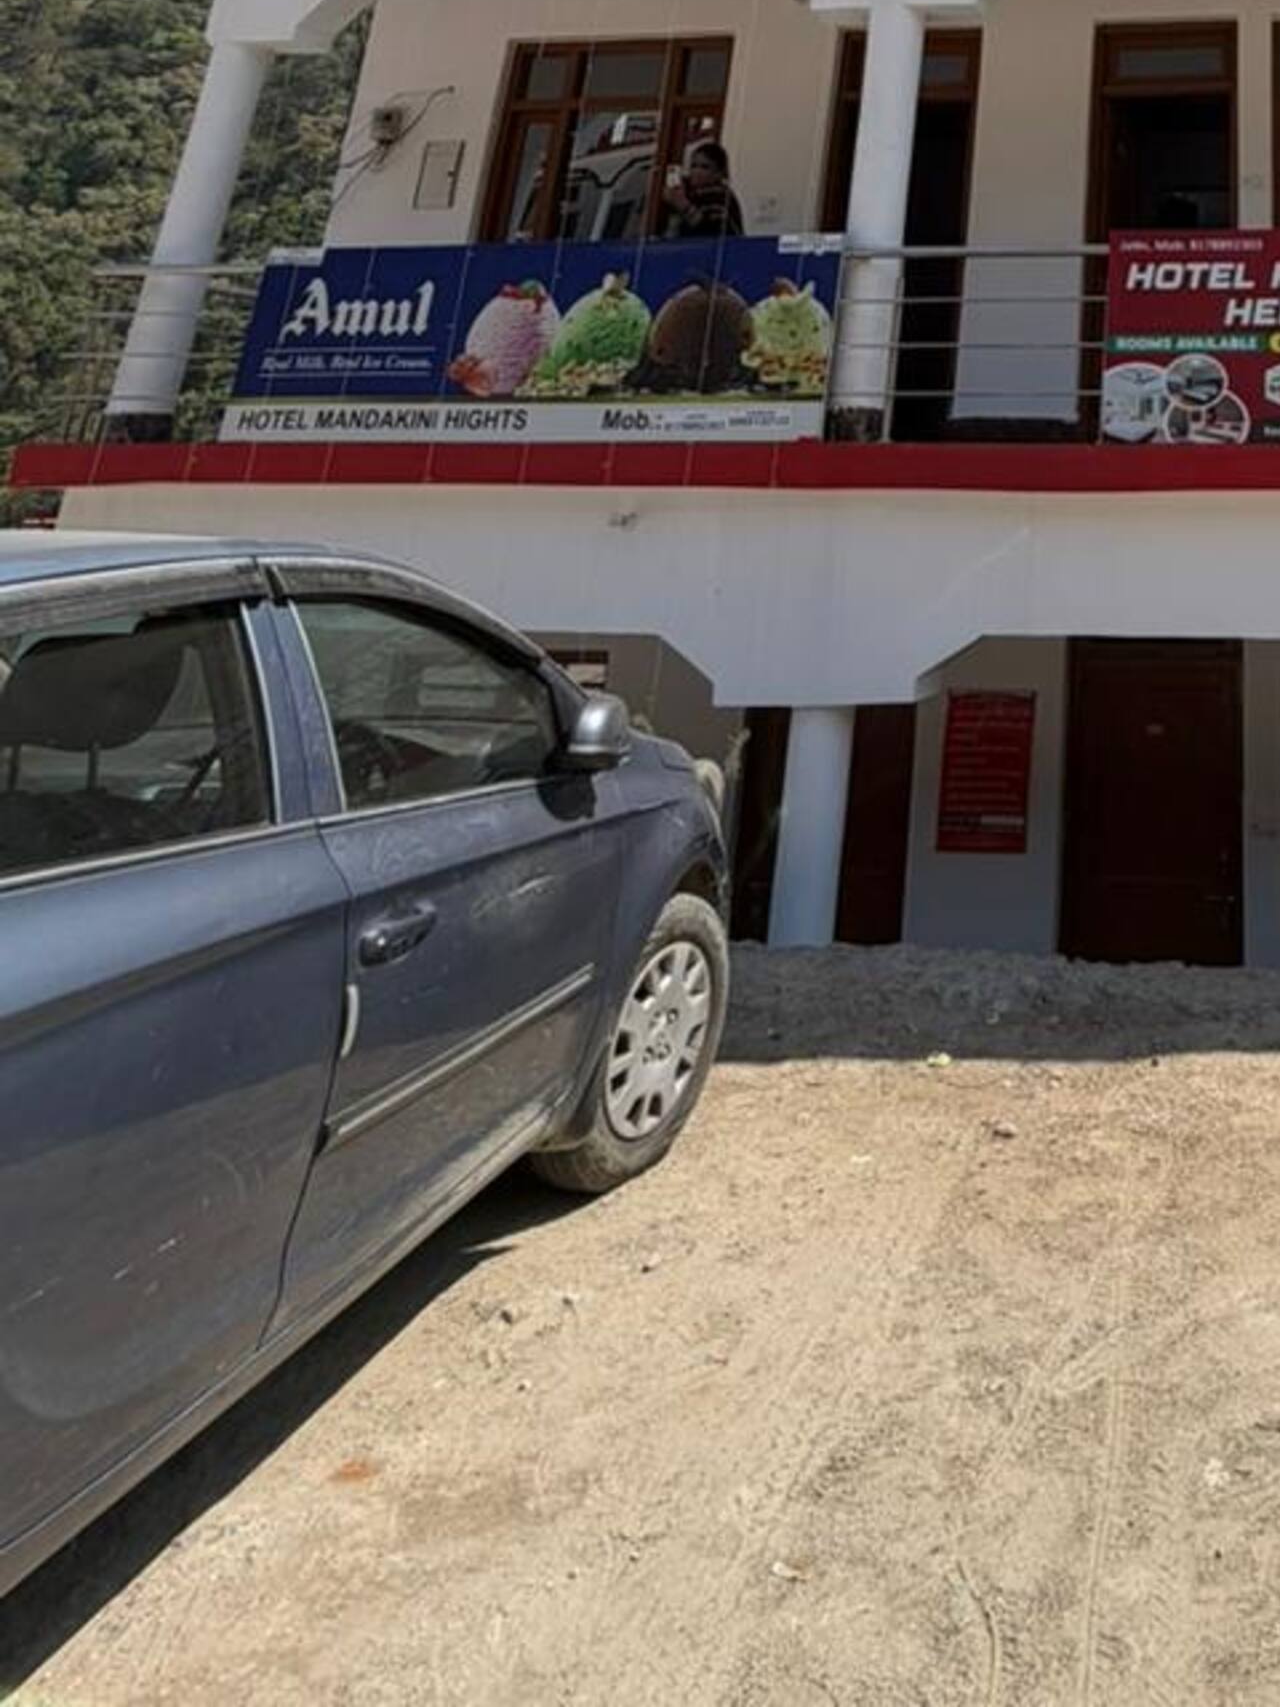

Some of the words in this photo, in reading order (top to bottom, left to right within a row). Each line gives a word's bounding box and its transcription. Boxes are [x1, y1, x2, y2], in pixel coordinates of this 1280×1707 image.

[1125, 261, 1257, 290] HOTEL
[278, 277, 434, 345] Amul
[1115, 335, 1171, 350] ROOMS
[1175, 334, 1258, 350] AVAILABLE
[236, 409, 308, 431] HOTEL
[314, 408, 437, 430] MANDAKINI
[444, 408, 529, 431] HIGHTS
